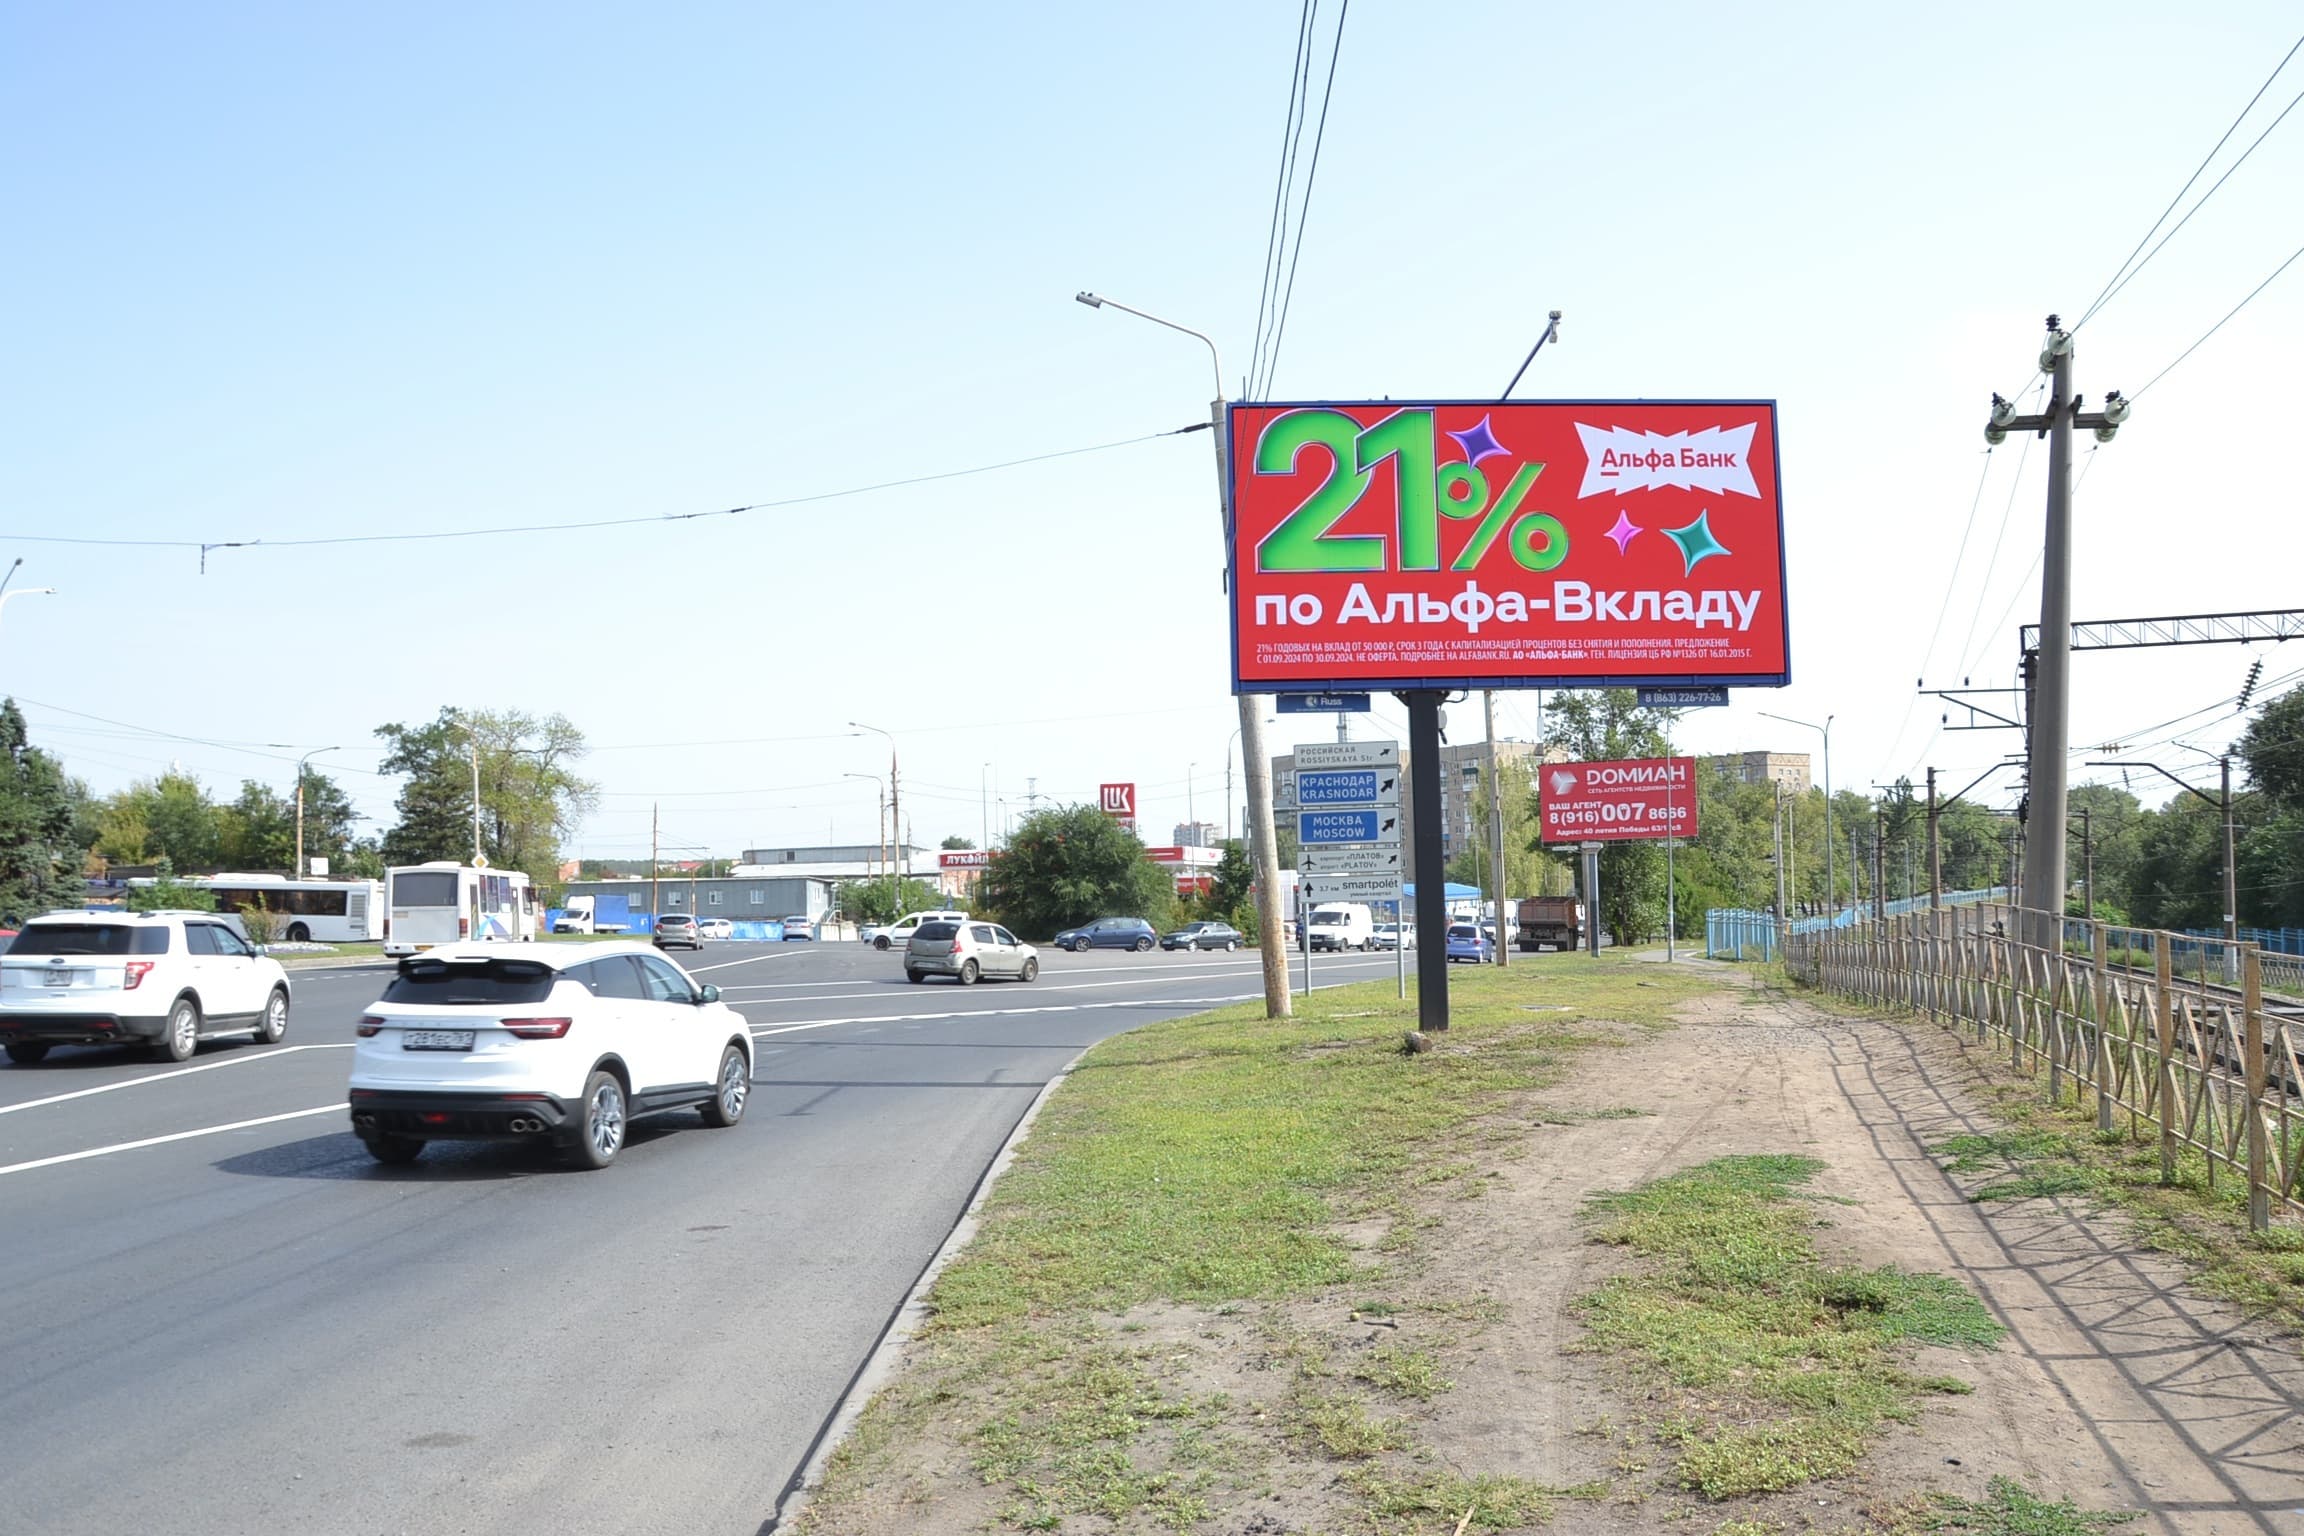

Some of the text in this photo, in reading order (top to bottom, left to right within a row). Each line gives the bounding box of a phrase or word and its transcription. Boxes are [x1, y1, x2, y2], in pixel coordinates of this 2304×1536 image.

[1601, 448, 1736, 474] Альфа Банк
[1254, 407, 1570, 573] 21%
[1255, 580, 1762, 634] по Альфа-Вкладу
[1257, 644, 1272, 652] 21%
[1274, 642, 1310, 653] ГОДОВЫХ
[1312, 642, 1322, 652] НА
[1324, 642, 1350, 652] ВКЛАД
[1352, 642, 1361, 651] ОТ
[1364, 642, 1373, 650] 50
[1374, 642, 1387, 650] 000
[1396, 641, 1416, 650] СРОК
[1417, 641, 1422, 650] 3
[1423, 640, 1444, 651] ГОДА
[1445, 640, 1450, 650] С
[1452, 639, 1521, 651] КАПИТАЛИЗАЦИЕЙ
[1523, 640, 1566, 650] ПРОЦЕНТОВ
[1568, 639, 1582, 649] БЕЗ
[1584, 639, 1613, 649] СНЯТИЯ
[1614, 639, 1619, 648] И
[1675, 638, 1729, 648] ПРЕДЛОЖЕНИЕ
[1257, 654, 1262, 664] С
[1263, 653, 1300, 663] 01.09.2024
[1302, 653, 1314, 662] ПО
[1356, 652, 1366, 662] НЕ
[1368, 652, 1398, 662] ОФЕРТА.
[1400, 652, 1445, 662] ПОДРОБНЕЕ
[1447, 651, 1458, 660] НА
[1459, 651, 1511, 660] ALFABANK.RU.
[1513, 650, 1523, 660] АО
[1608, 650, 1647, 660] ЛИЦЕНЗИЯ
[1649, 649, 1660, 660] ЦБ
[1661, 649, 1671, 659] РФ
[1700, 649, 1708, 658] ОТ
[1710, 648, 1745, 658] 16.01.2015
[1645, 693, 1721, 703] 8 (863) 226-77-26
[1300, 746, 1356, 755] РОССИЙСКАЯ
[1301, 756, 1357, 764] ROSSIYSKAYA
[1301, 775, 1374, 788] КРАСНОДАР
[1302, 788, 1374, 800] KRASNODAR
[1572, 801, 1602, 809] АГЕНТ
[1550, 802, 1686, 826] 8 (916) 007 8666
[1313, 815, 1363, 827] МОСКВА
[1313, 827, 1365, 838] MOSCOW
[946, 852, 989, 864] ЛУКОЙЛ
